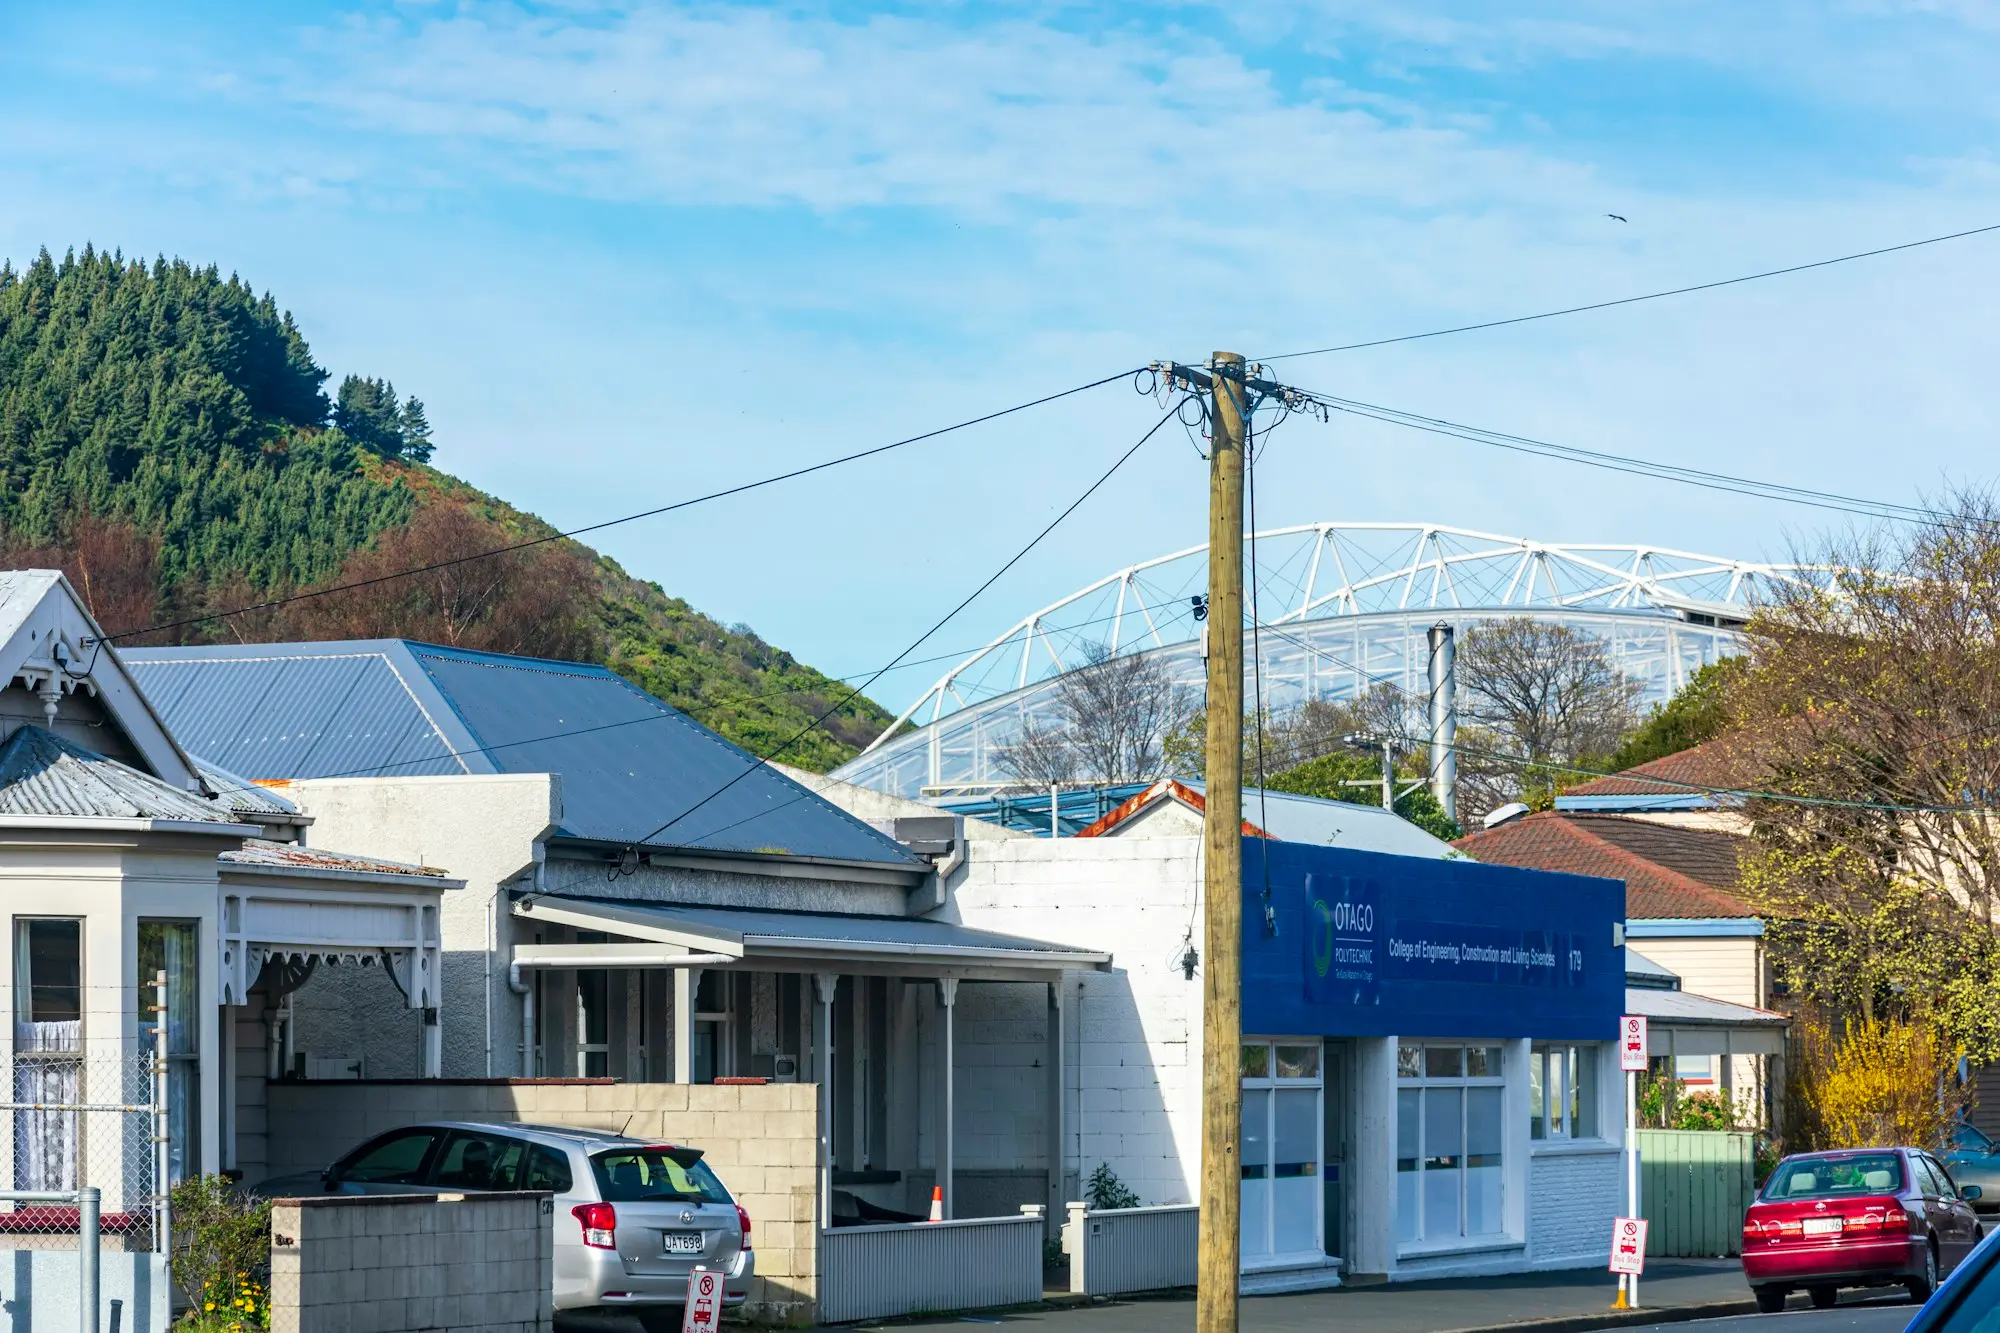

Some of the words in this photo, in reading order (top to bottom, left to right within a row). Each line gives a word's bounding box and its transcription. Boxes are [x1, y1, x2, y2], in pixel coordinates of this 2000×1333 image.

[1335, 902, 1373, 932] OTAGO
[1335, 948, 1373, 964] POLYTECHNIC
[1388, 938, 1414, 962] College
[1414, 940, 1422, 958] of
[1461, 943, 1500, 962] Construction
[1500, 946, 1511, 963] and
[1512, 946, 1529, 970] Living
[1530, 948, 1556, 967] Sciences
[1569, 950, 1582, 971] 179
[1623, 1053, 1633, 1061] Bus
[1634, 1052, 1645, 1061] Stop
[666, 1236, 702, 1250] JAT698
[1613, 1254, 1625, 1264] Bus
[1627, 1255, 1641, 1265] Stop
